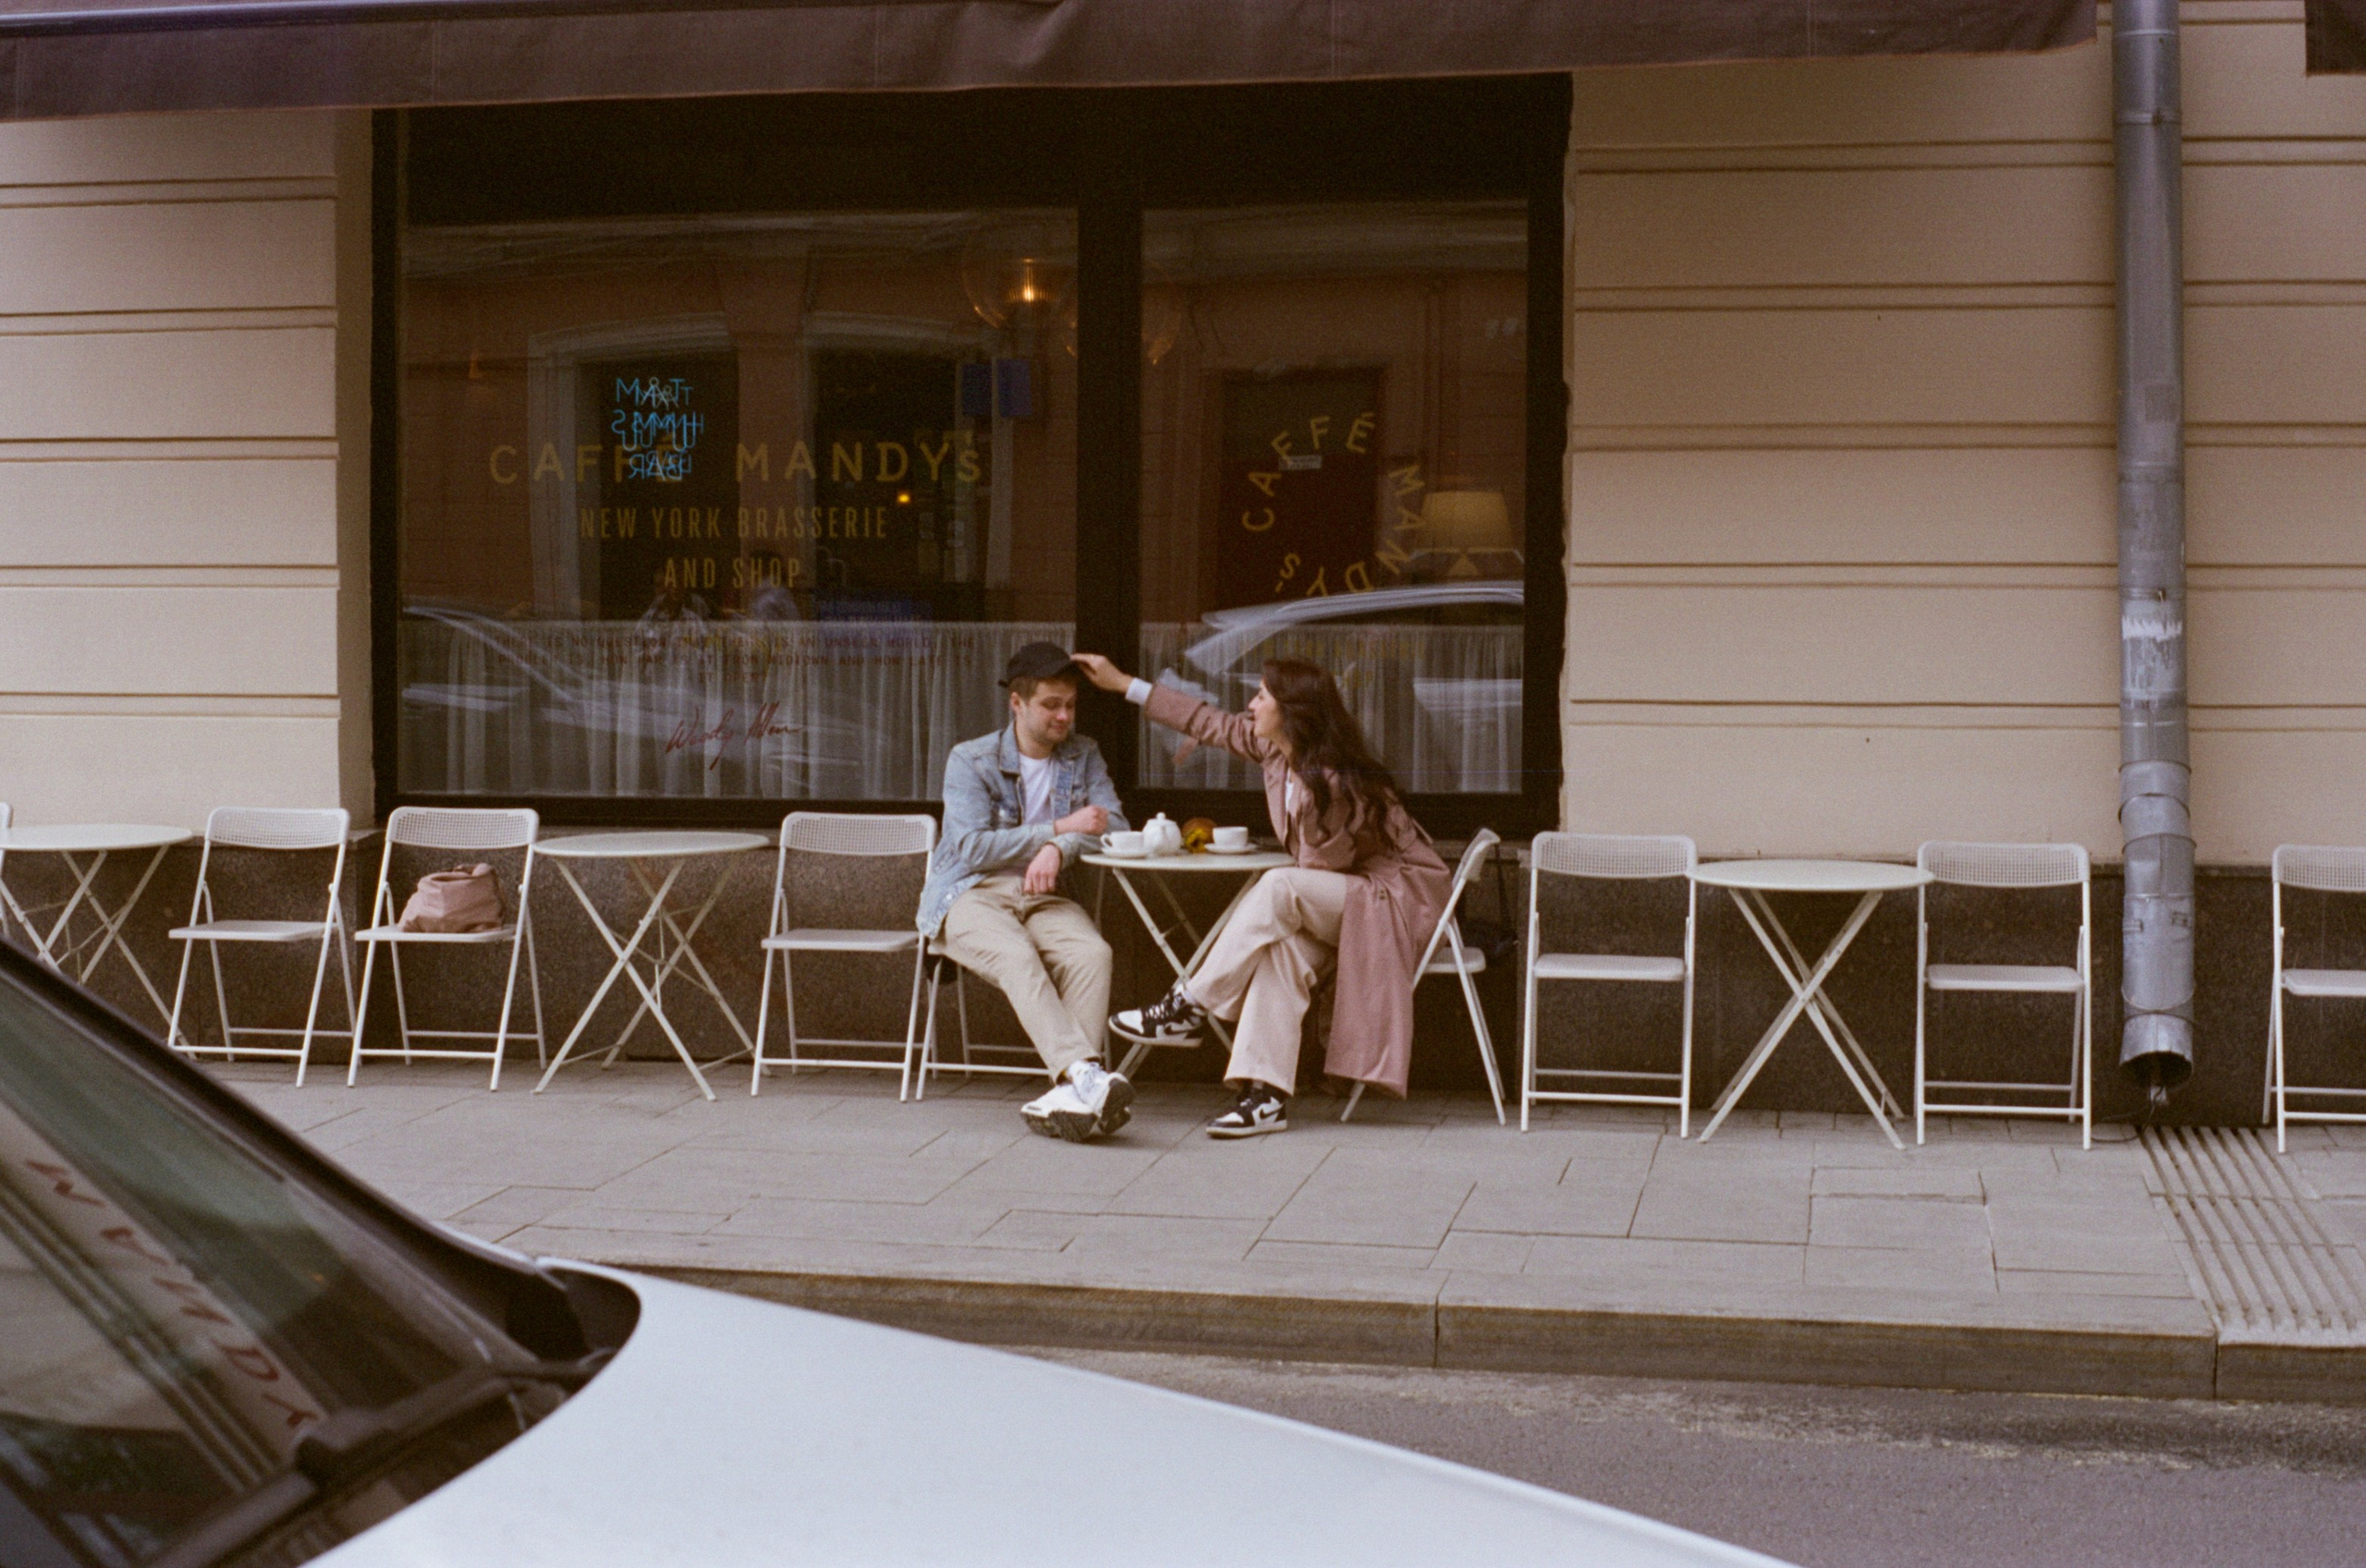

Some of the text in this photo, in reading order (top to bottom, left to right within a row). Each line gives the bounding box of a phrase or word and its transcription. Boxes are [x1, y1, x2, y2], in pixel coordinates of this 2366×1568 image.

[579, 506, 887, 539] NEW YORK BRASSERIE
[665, 556, 800, 589] AND SHOP
